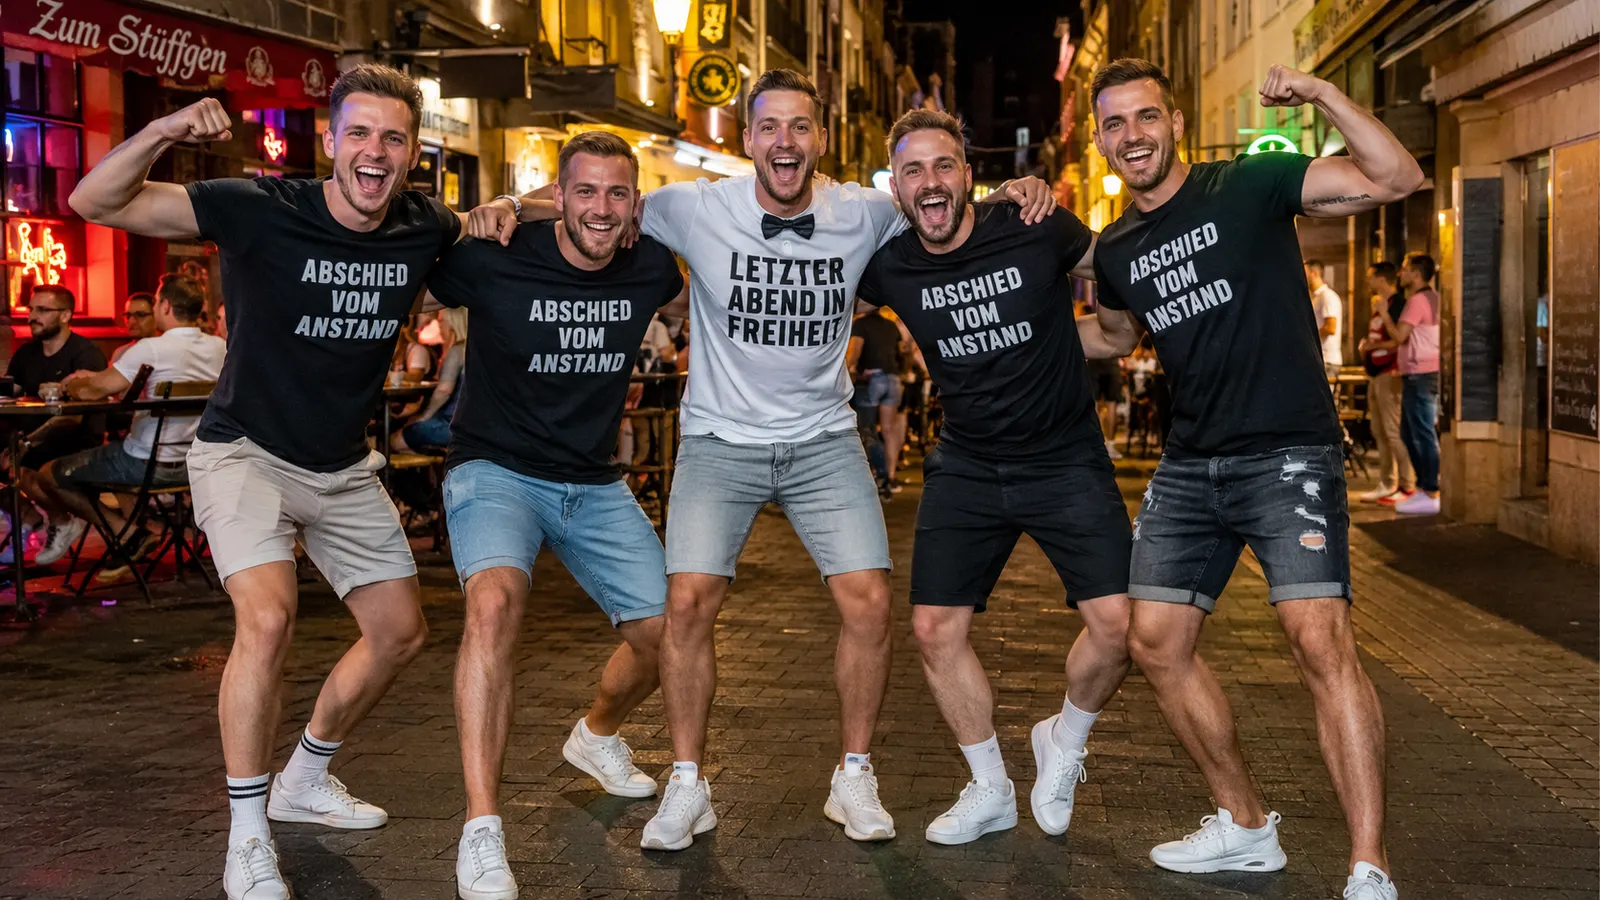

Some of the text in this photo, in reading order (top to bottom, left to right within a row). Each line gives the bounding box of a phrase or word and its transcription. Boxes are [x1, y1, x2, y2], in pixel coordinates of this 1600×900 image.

[29, 0, 227, 80] Zum Stüffgen
[730, 251, 845, 286] LETZTER
[1130, 221, 1219, 285] ABSCHIED
[300, 258, 408, 287] ABSCHIED
[921, 266, 1023, 311] ABSCHIED
[1152, 260, 1199, 299] VOM
[331, 289, 380, 315] VOM
[528, 299, 632, 323] ABSCHIED
[727, 284, 846, 317] ABEND IN
[949, 300, 1001, 332] VOM
[1144, 278, 1233, 334] ANSTAND
[293, 314, 399, 340] ANSTAND
[558, 327, 605, 350] VOM
[727, 314, 843, 347] FREIHEIT
[936, 320, 1033, 358] ANSTAND
[527, 352, 626, 374] ANSTAND
